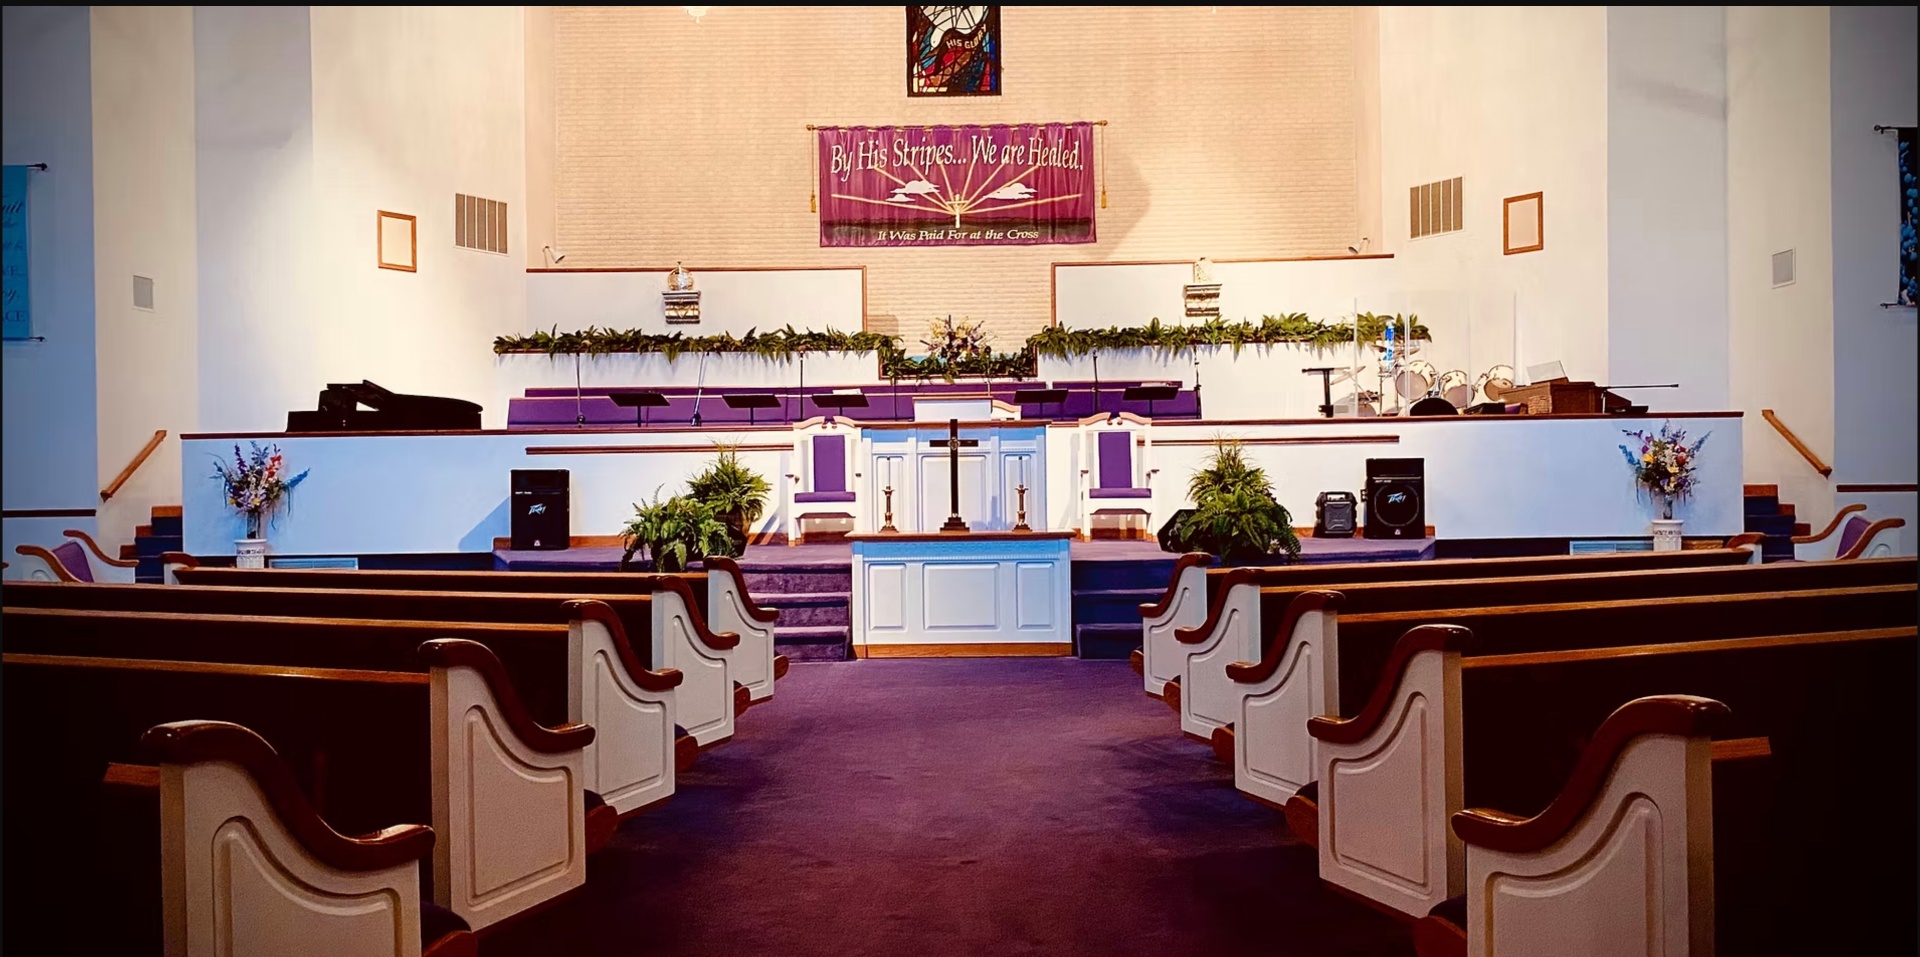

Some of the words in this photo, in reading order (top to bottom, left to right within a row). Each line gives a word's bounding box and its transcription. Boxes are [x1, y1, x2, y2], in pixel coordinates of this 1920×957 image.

[946, 39, 962, 49] HIS
[964, 24, 986, 49] GLORY
[831, 145, 852, 181] By
[857, 140, 887, 170] His
[893, 137, 967, 175] Stripes...
[971, 136, 996, 165] We
[1001, 144, 1024, 165] are
[1028, 137, 1083, 170] Healed.
[877, 231, 887, 241] It
[889, 231, 915, 241] Was
[918, 230, 944, 240] Paid
[947, 229, 968, 240] For
[970, 230, 984, 240] at
[986, 229, 1003, 240] the
[1007, 229, 1039, 240] Cross
